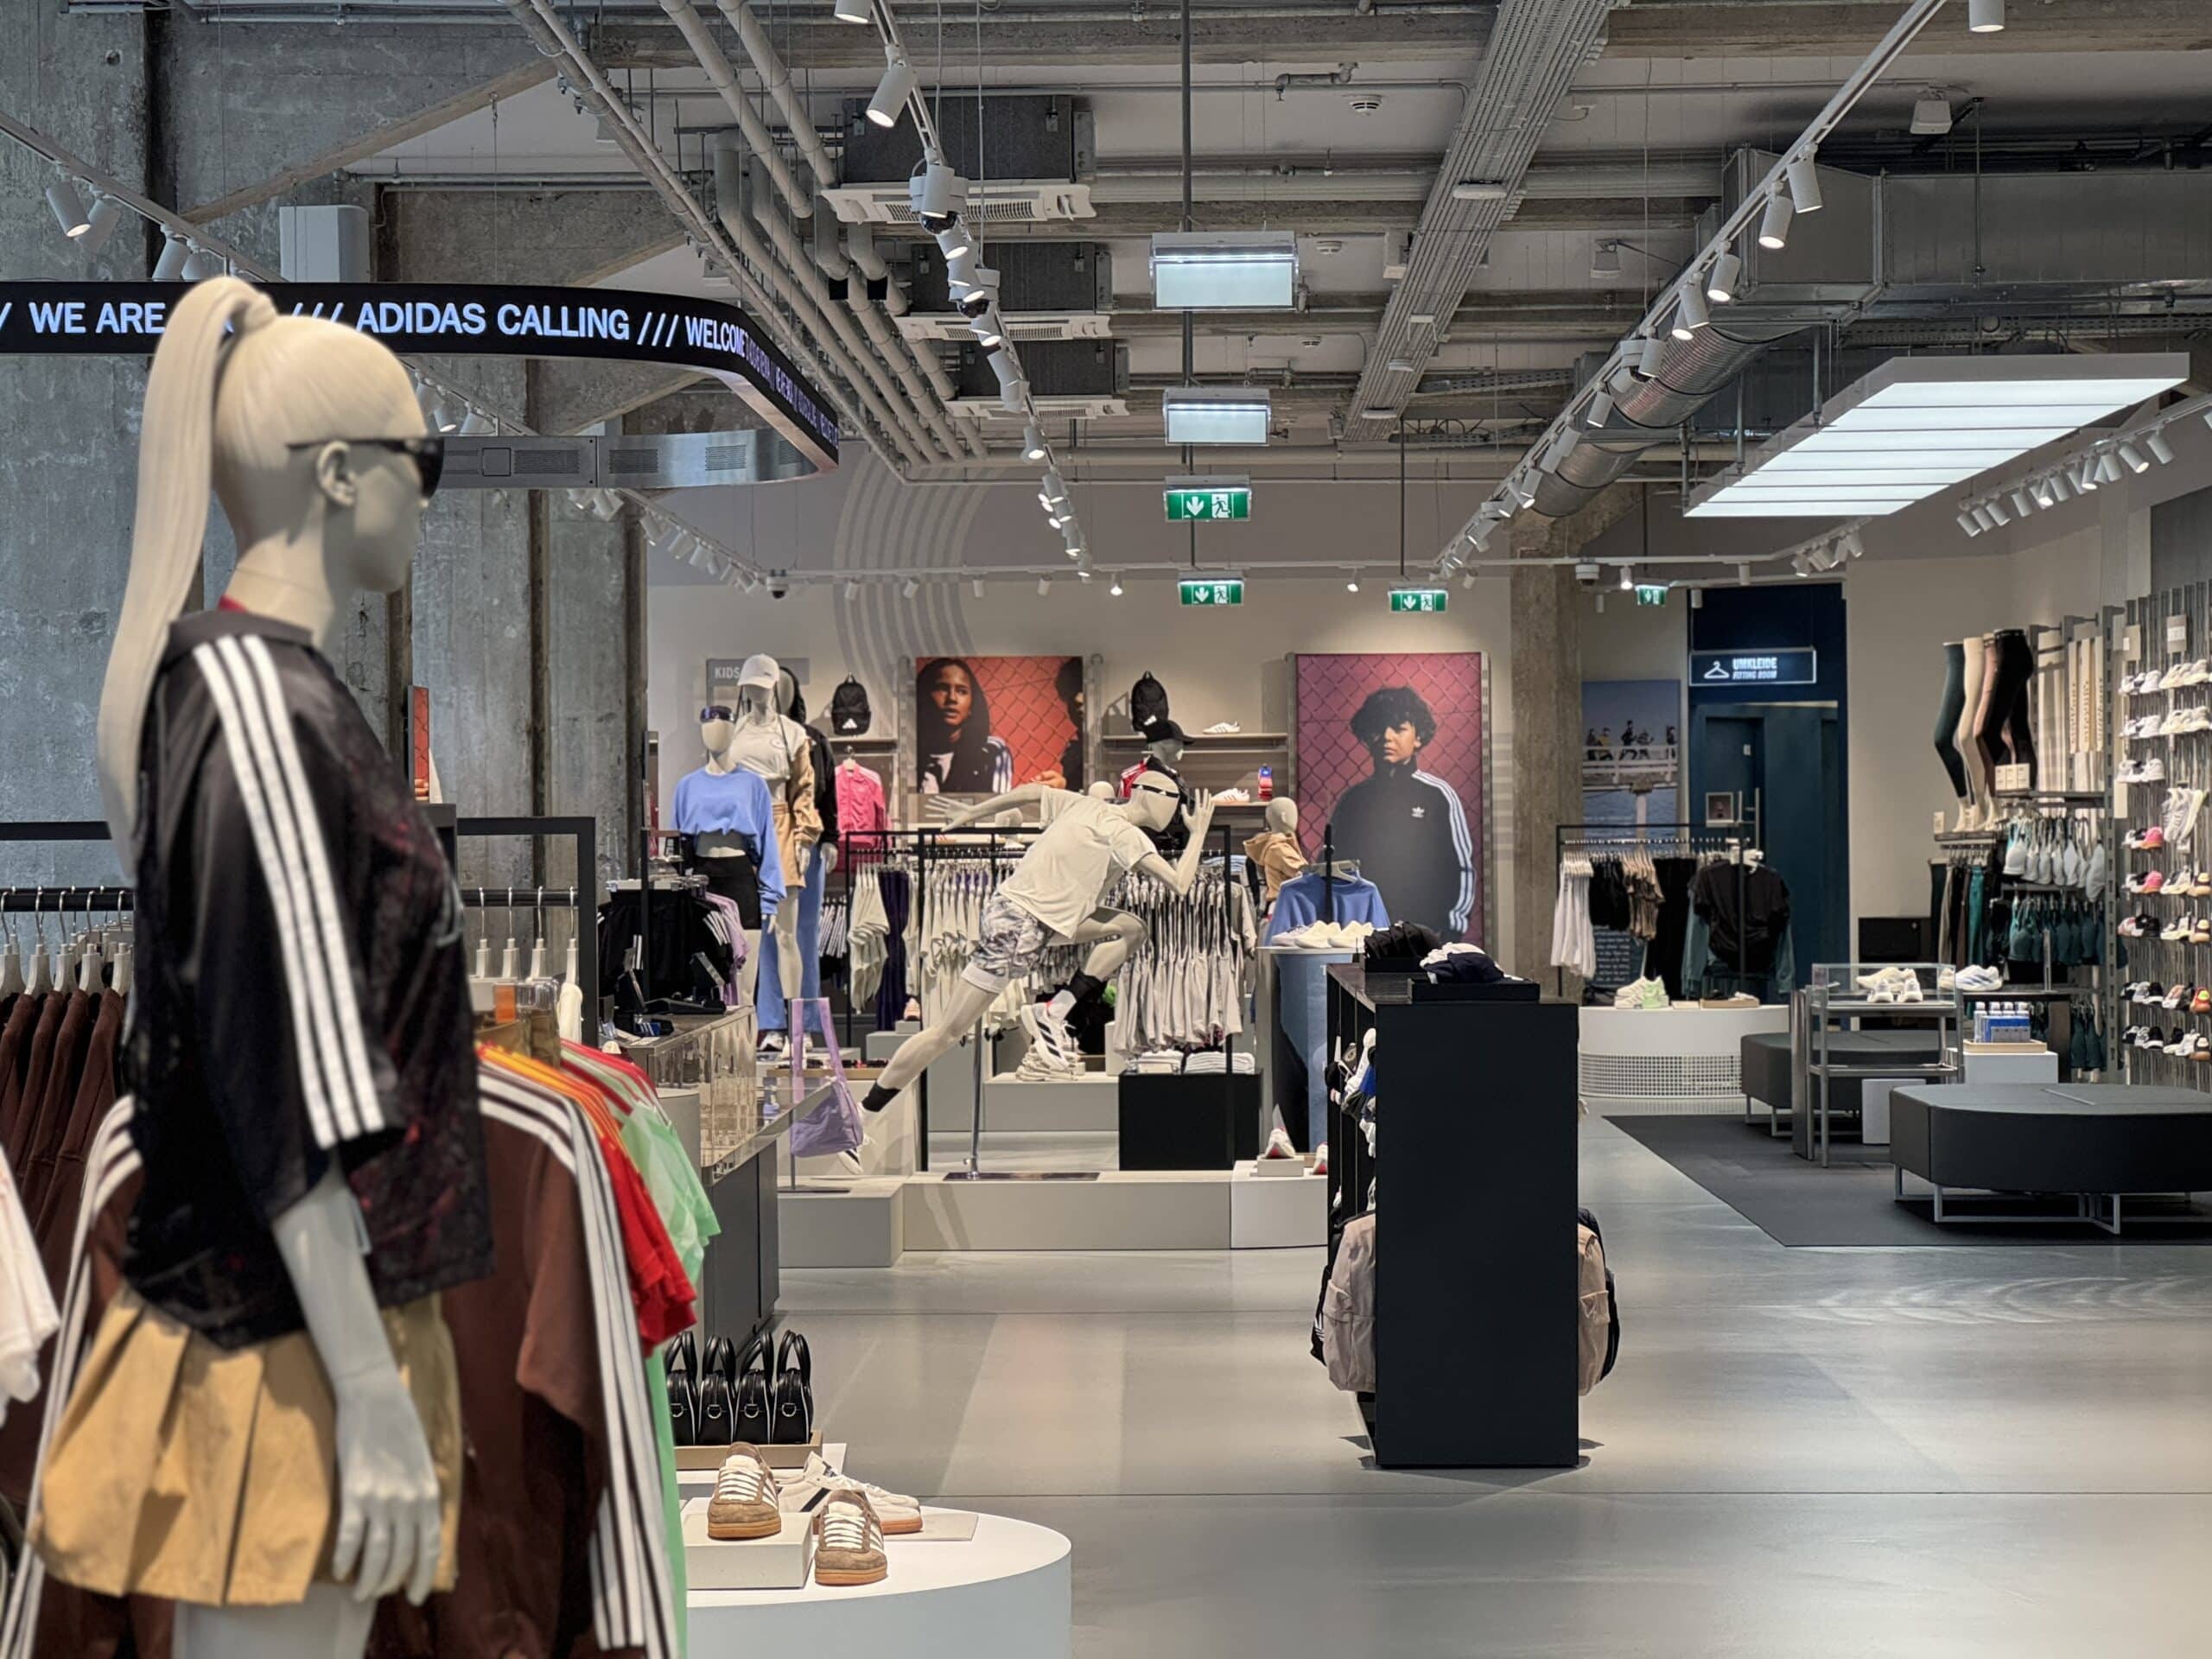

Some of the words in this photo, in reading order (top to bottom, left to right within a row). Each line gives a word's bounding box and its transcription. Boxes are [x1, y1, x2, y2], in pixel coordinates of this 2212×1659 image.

[29, 302, 86, 334] WE
[95, 302, 166, 334] ARE
[355, 302, 486, 334] ADIDAS
[497, 303, 630, 340] CALLING
[684, 315, 747, 359] WELCOME
[1732, 658, 1777, 671] UMKLEIDE
[714, 666, 741, 678] KIDS
